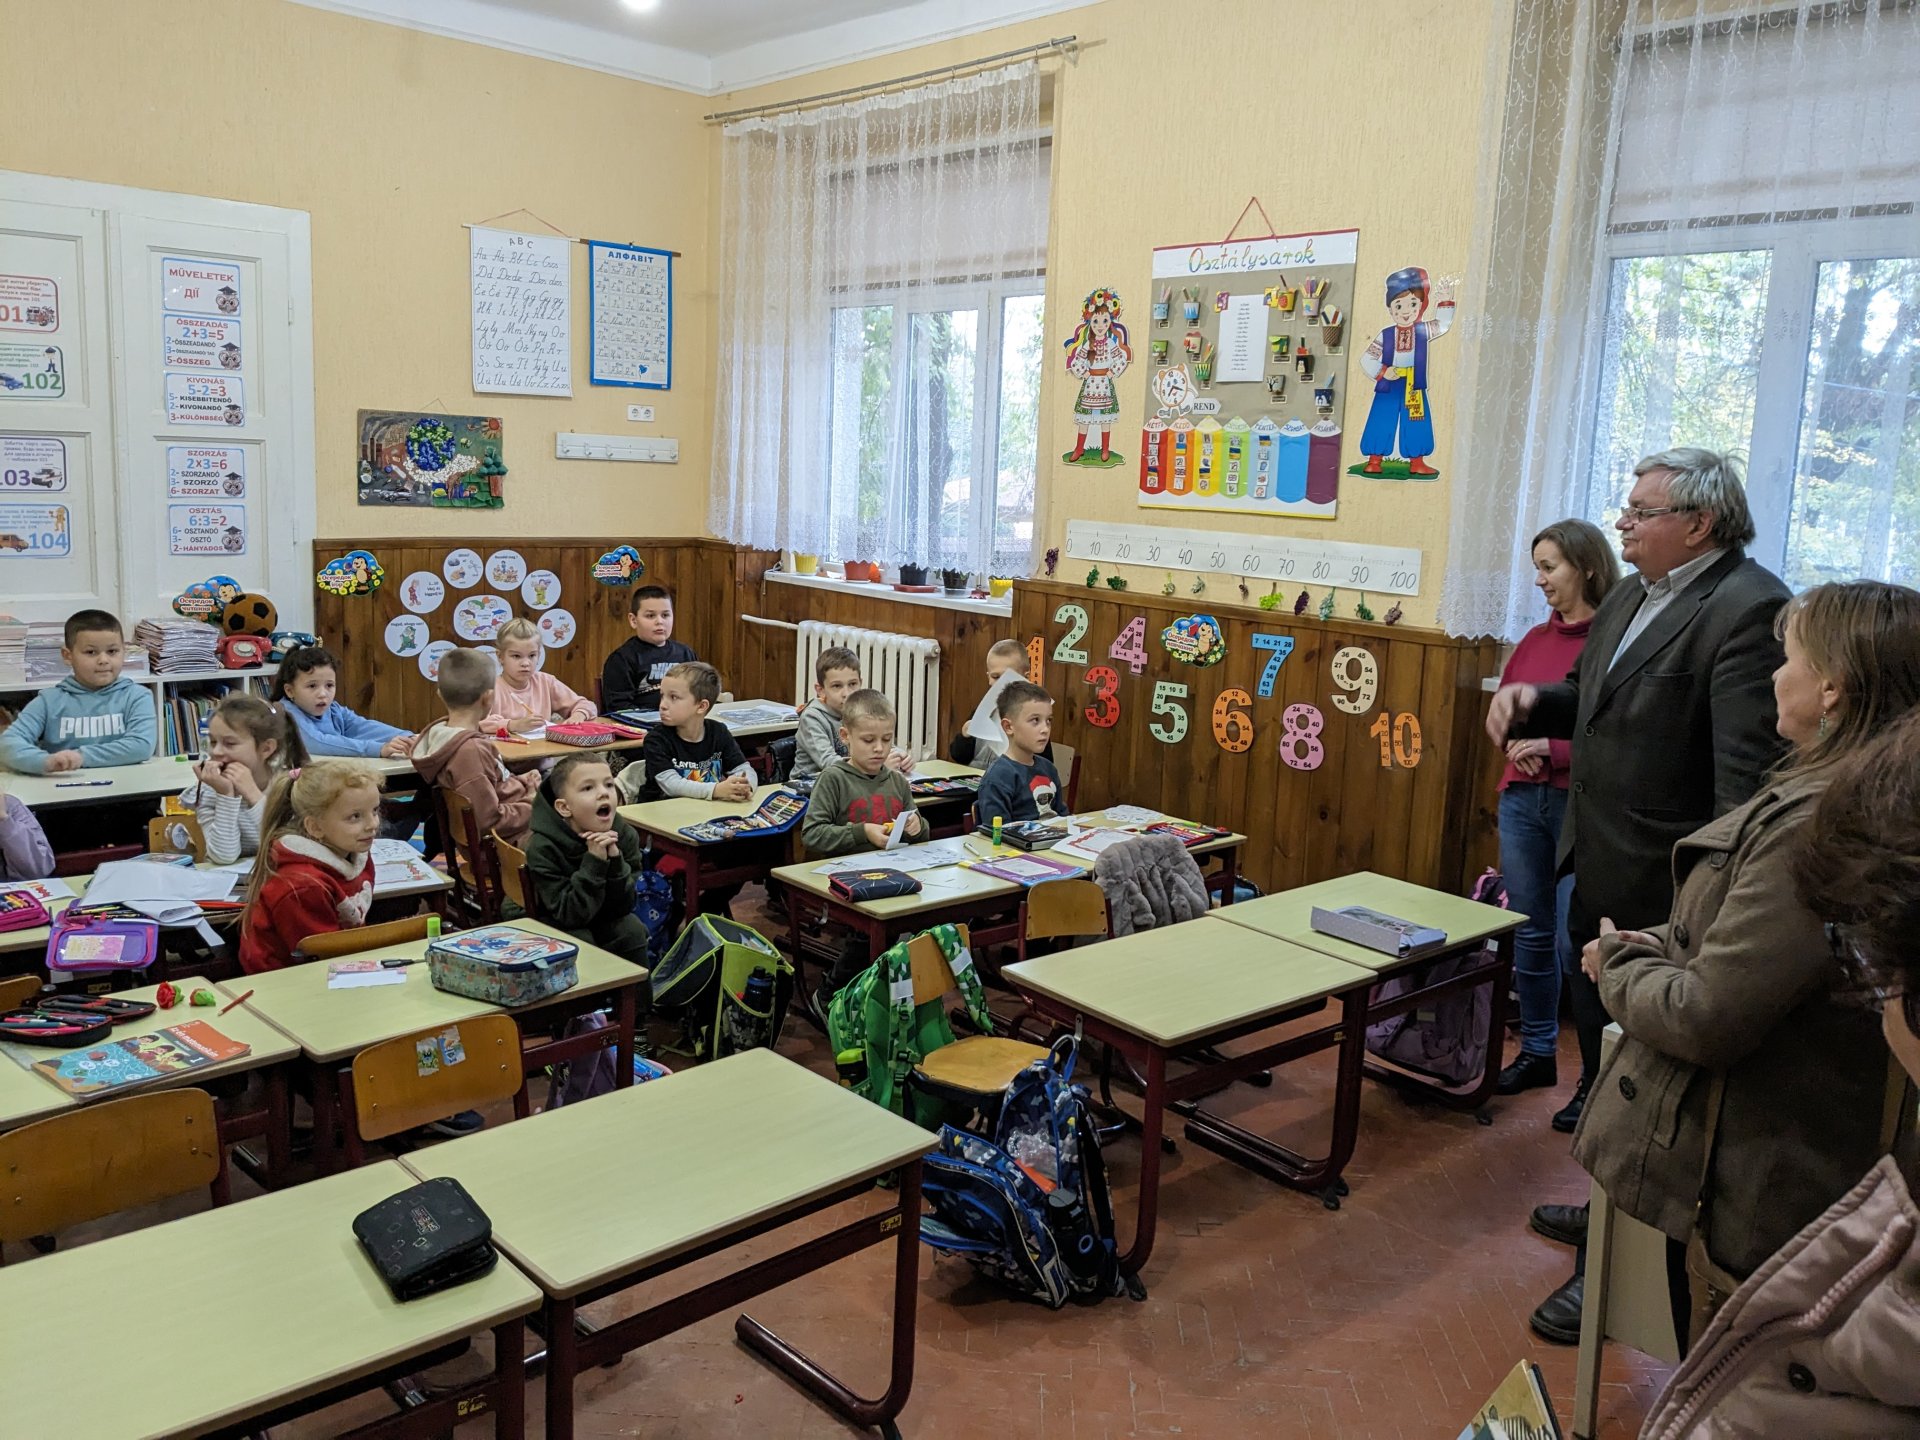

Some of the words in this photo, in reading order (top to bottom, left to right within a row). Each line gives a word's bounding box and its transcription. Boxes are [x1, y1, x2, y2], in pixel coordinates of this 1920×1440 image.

[608, 251, 654, 263] АЛФАВІТ
[1189, 238, 1316, 273] Osztálysarok
[22, 372, 62, 390] 102
[28, 532, 68, 549] 104
[1066, 538, 1072, 553] 0
[1089, 541, 1101, 556] 10
[1115, 543, 1131, 558] 20
[1145, 545, 1161, 561] 30
[1178, 548, 1192, 565] 40
[1209, 551, 1226, 568] 50
[1242, 554, 1260, 572] 60
[1279, 558, 1295, 575] 70
[1312, 561, 1330, 579] 80
[1349, 566, 1369, 584] 90
[1389, 571, 1417, 589] 100
[1053, 604, 1089, 664] 2
[1110, 616, 1149, 674] 4
[1252, 633, 1295, 698] 7
[1331, 646, 1378, 714] 9
[59, 713, 125, 739] PUMA
[1084, 666, 1121, 728] 3
[1149, 681, 1188, 743] 5
[1212, 688, 1254, 753] 6
[1279, 703, 1324, 771] 8
[1370, 712, 1421, 768] 10
